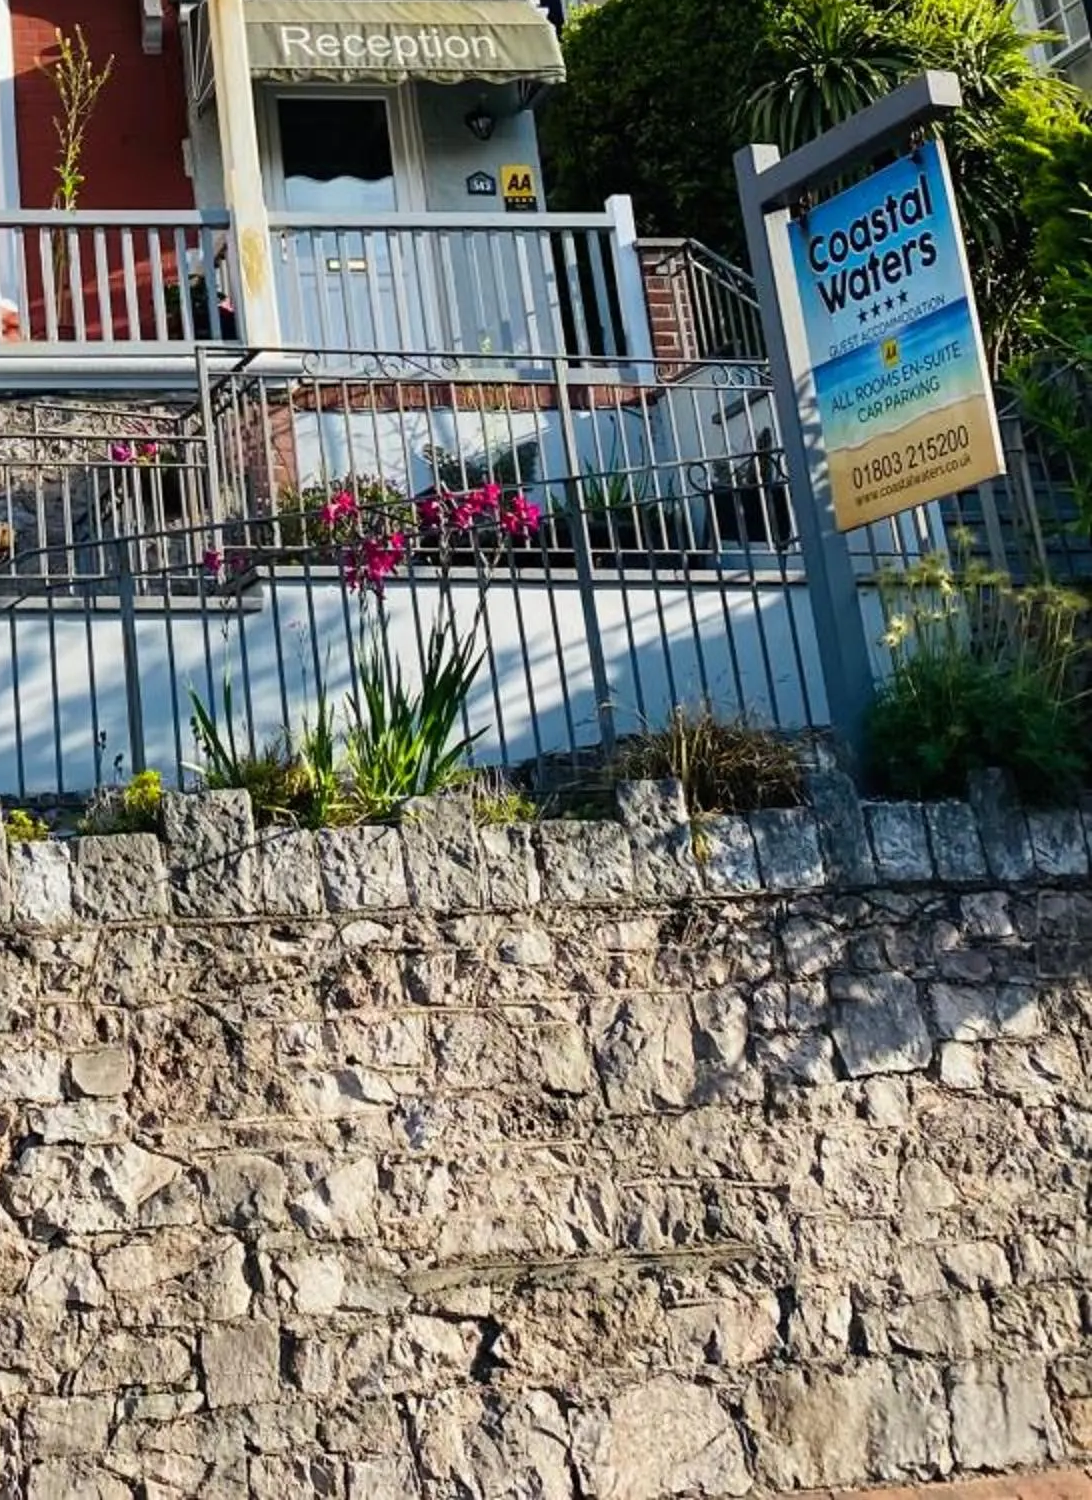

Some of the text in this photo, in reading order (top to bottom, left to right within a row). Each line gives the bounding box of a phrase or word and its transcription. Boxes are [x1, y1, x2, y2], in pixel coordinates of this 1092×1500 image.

[280, 26, 497, 65] Reception
[508, 173, 532, 191] AA
[809, 173, 933, 272] Coastal
[817, 232, 937, 313] Waters
[829, 334, 858, 357] GUEST
[831, 340, 962, 413] ALL ROOMS EN-SUITE
[857, 375, 940, 423] CAR PARKING
[853, 425, 968, 489] 01803 215200
